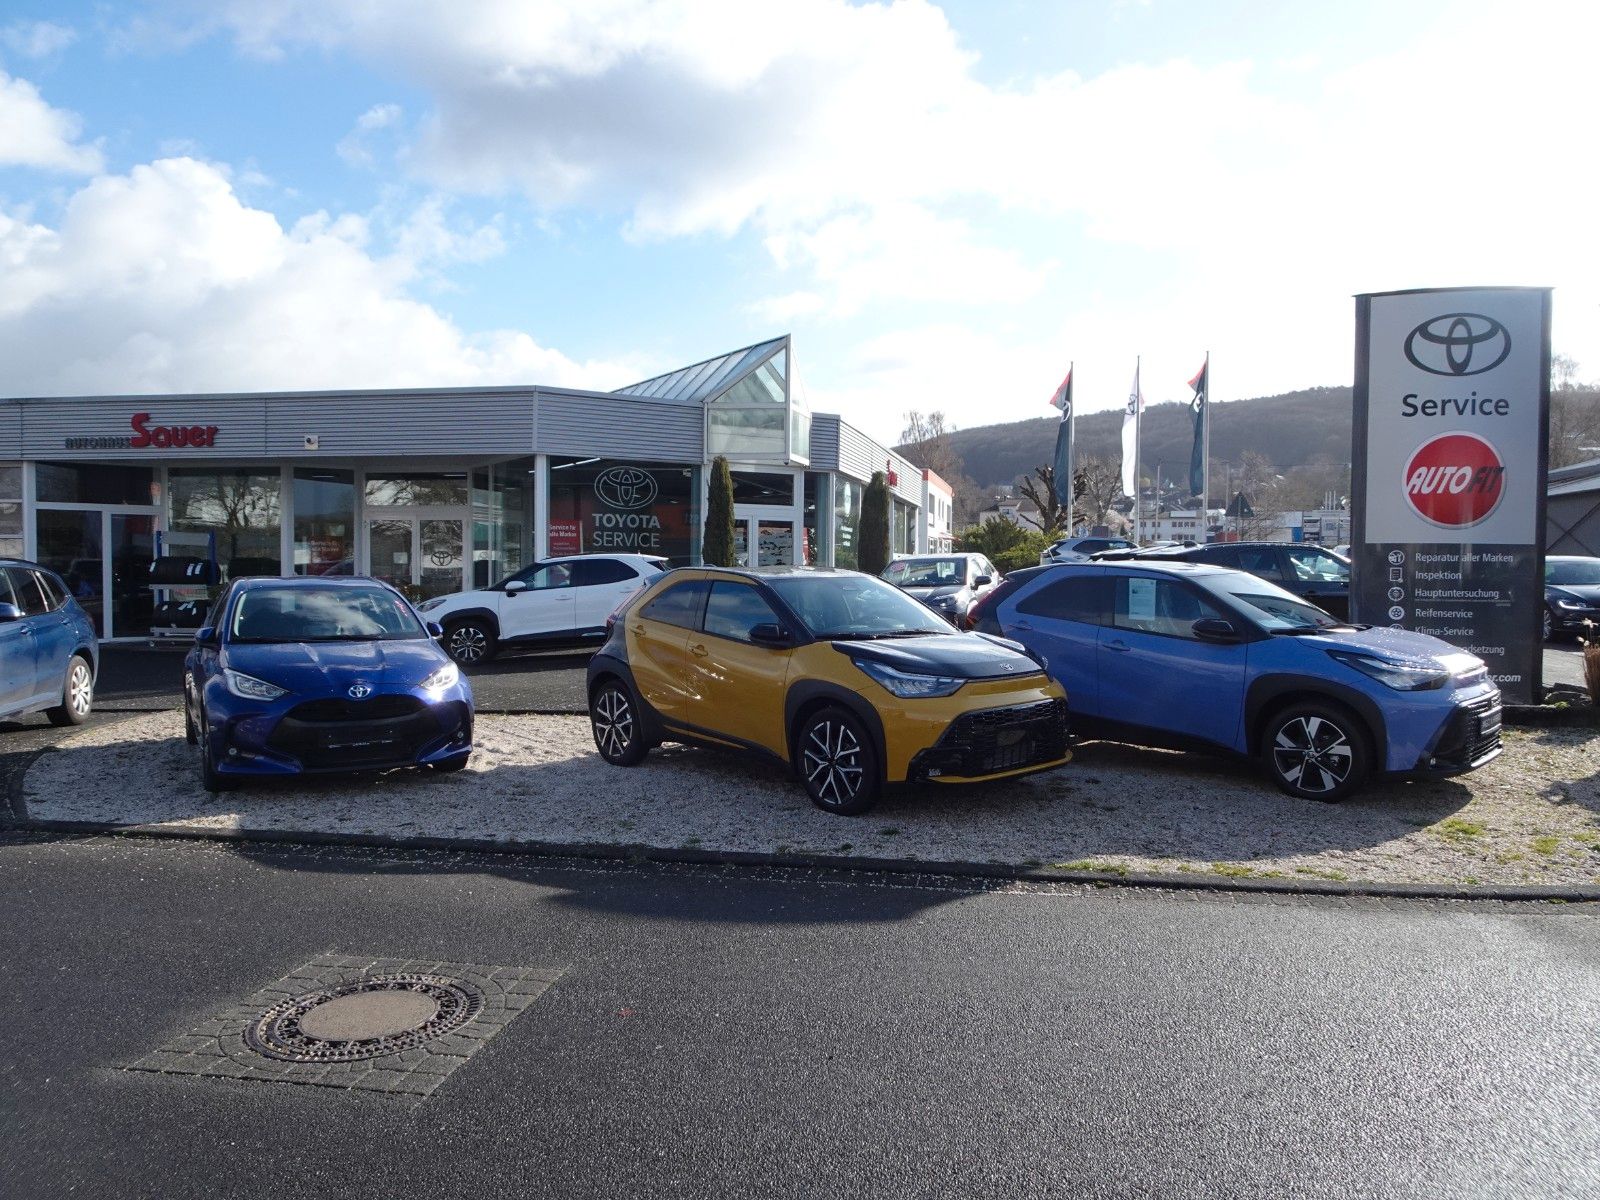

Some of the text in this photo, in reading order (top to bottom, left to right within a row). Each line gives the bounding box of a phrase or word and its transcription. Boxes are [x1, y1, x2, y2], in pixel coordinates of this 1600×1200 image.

[1401, 391, 1509, 417] Service
[130, 413, 219, 448] Sauer
[1407, 465, 1505, 494] AUTOFIT
[592, 513, 661, 528] TOYOTA
[592, 531, 660, 547] SERVICE
[1415, 552, 1514, 563] Reparatur aller Marken
[1415, 570, 1462, 581] Inspektion
[1415, 588, 1500, 599] Hauptuntersuchung
[1415, 608, 1473, 618] Reifenservice
[1414, 626, 1474, 636] Klima-Service
[1463, 644, 1505, 656] dsetzung
